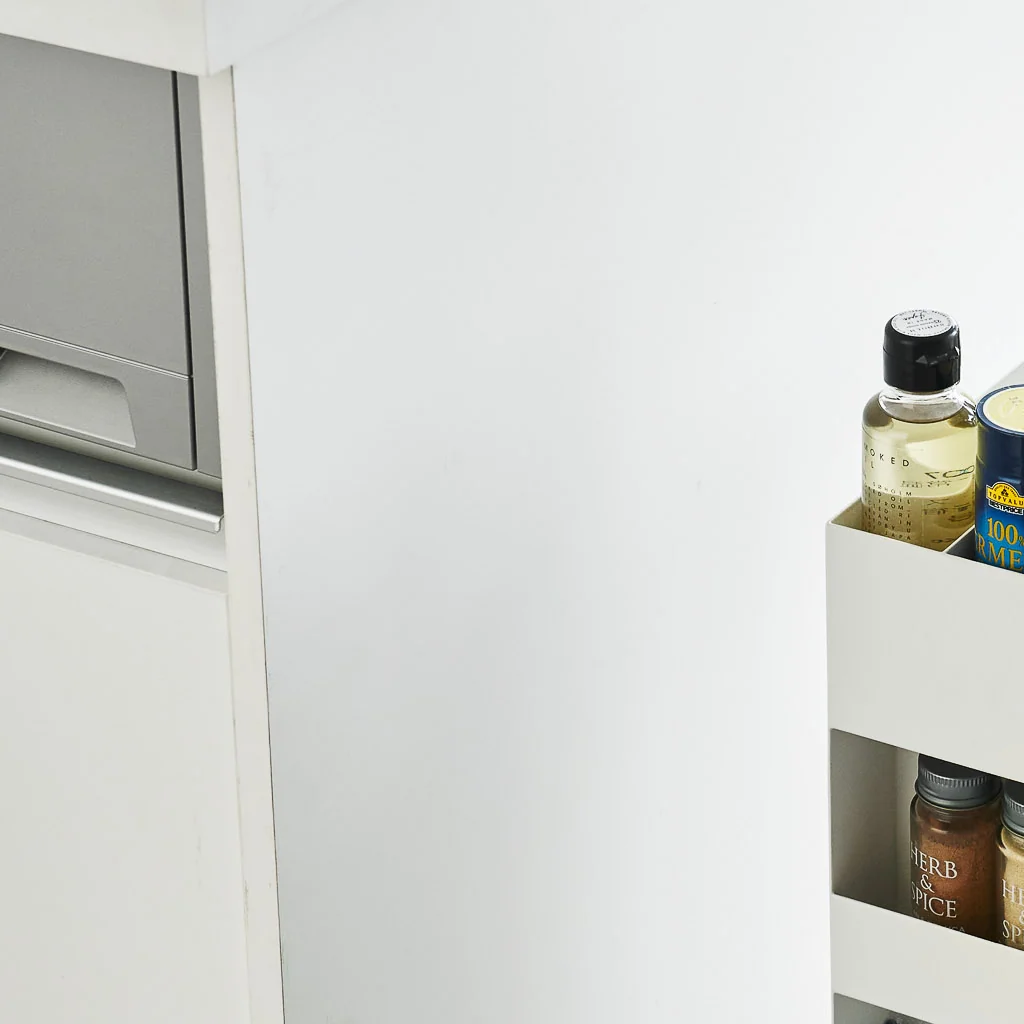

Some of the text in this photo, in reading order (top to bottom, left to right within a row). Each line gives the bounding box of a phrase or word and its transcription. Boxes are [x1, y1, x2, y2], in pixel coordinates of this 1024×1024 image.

[988, 491, 1024, 507] TOPVALU
[911, 841, 957, 879] HERB
[920, 873, 935, 893] &
[911, 881, 957, 918] SPICE
